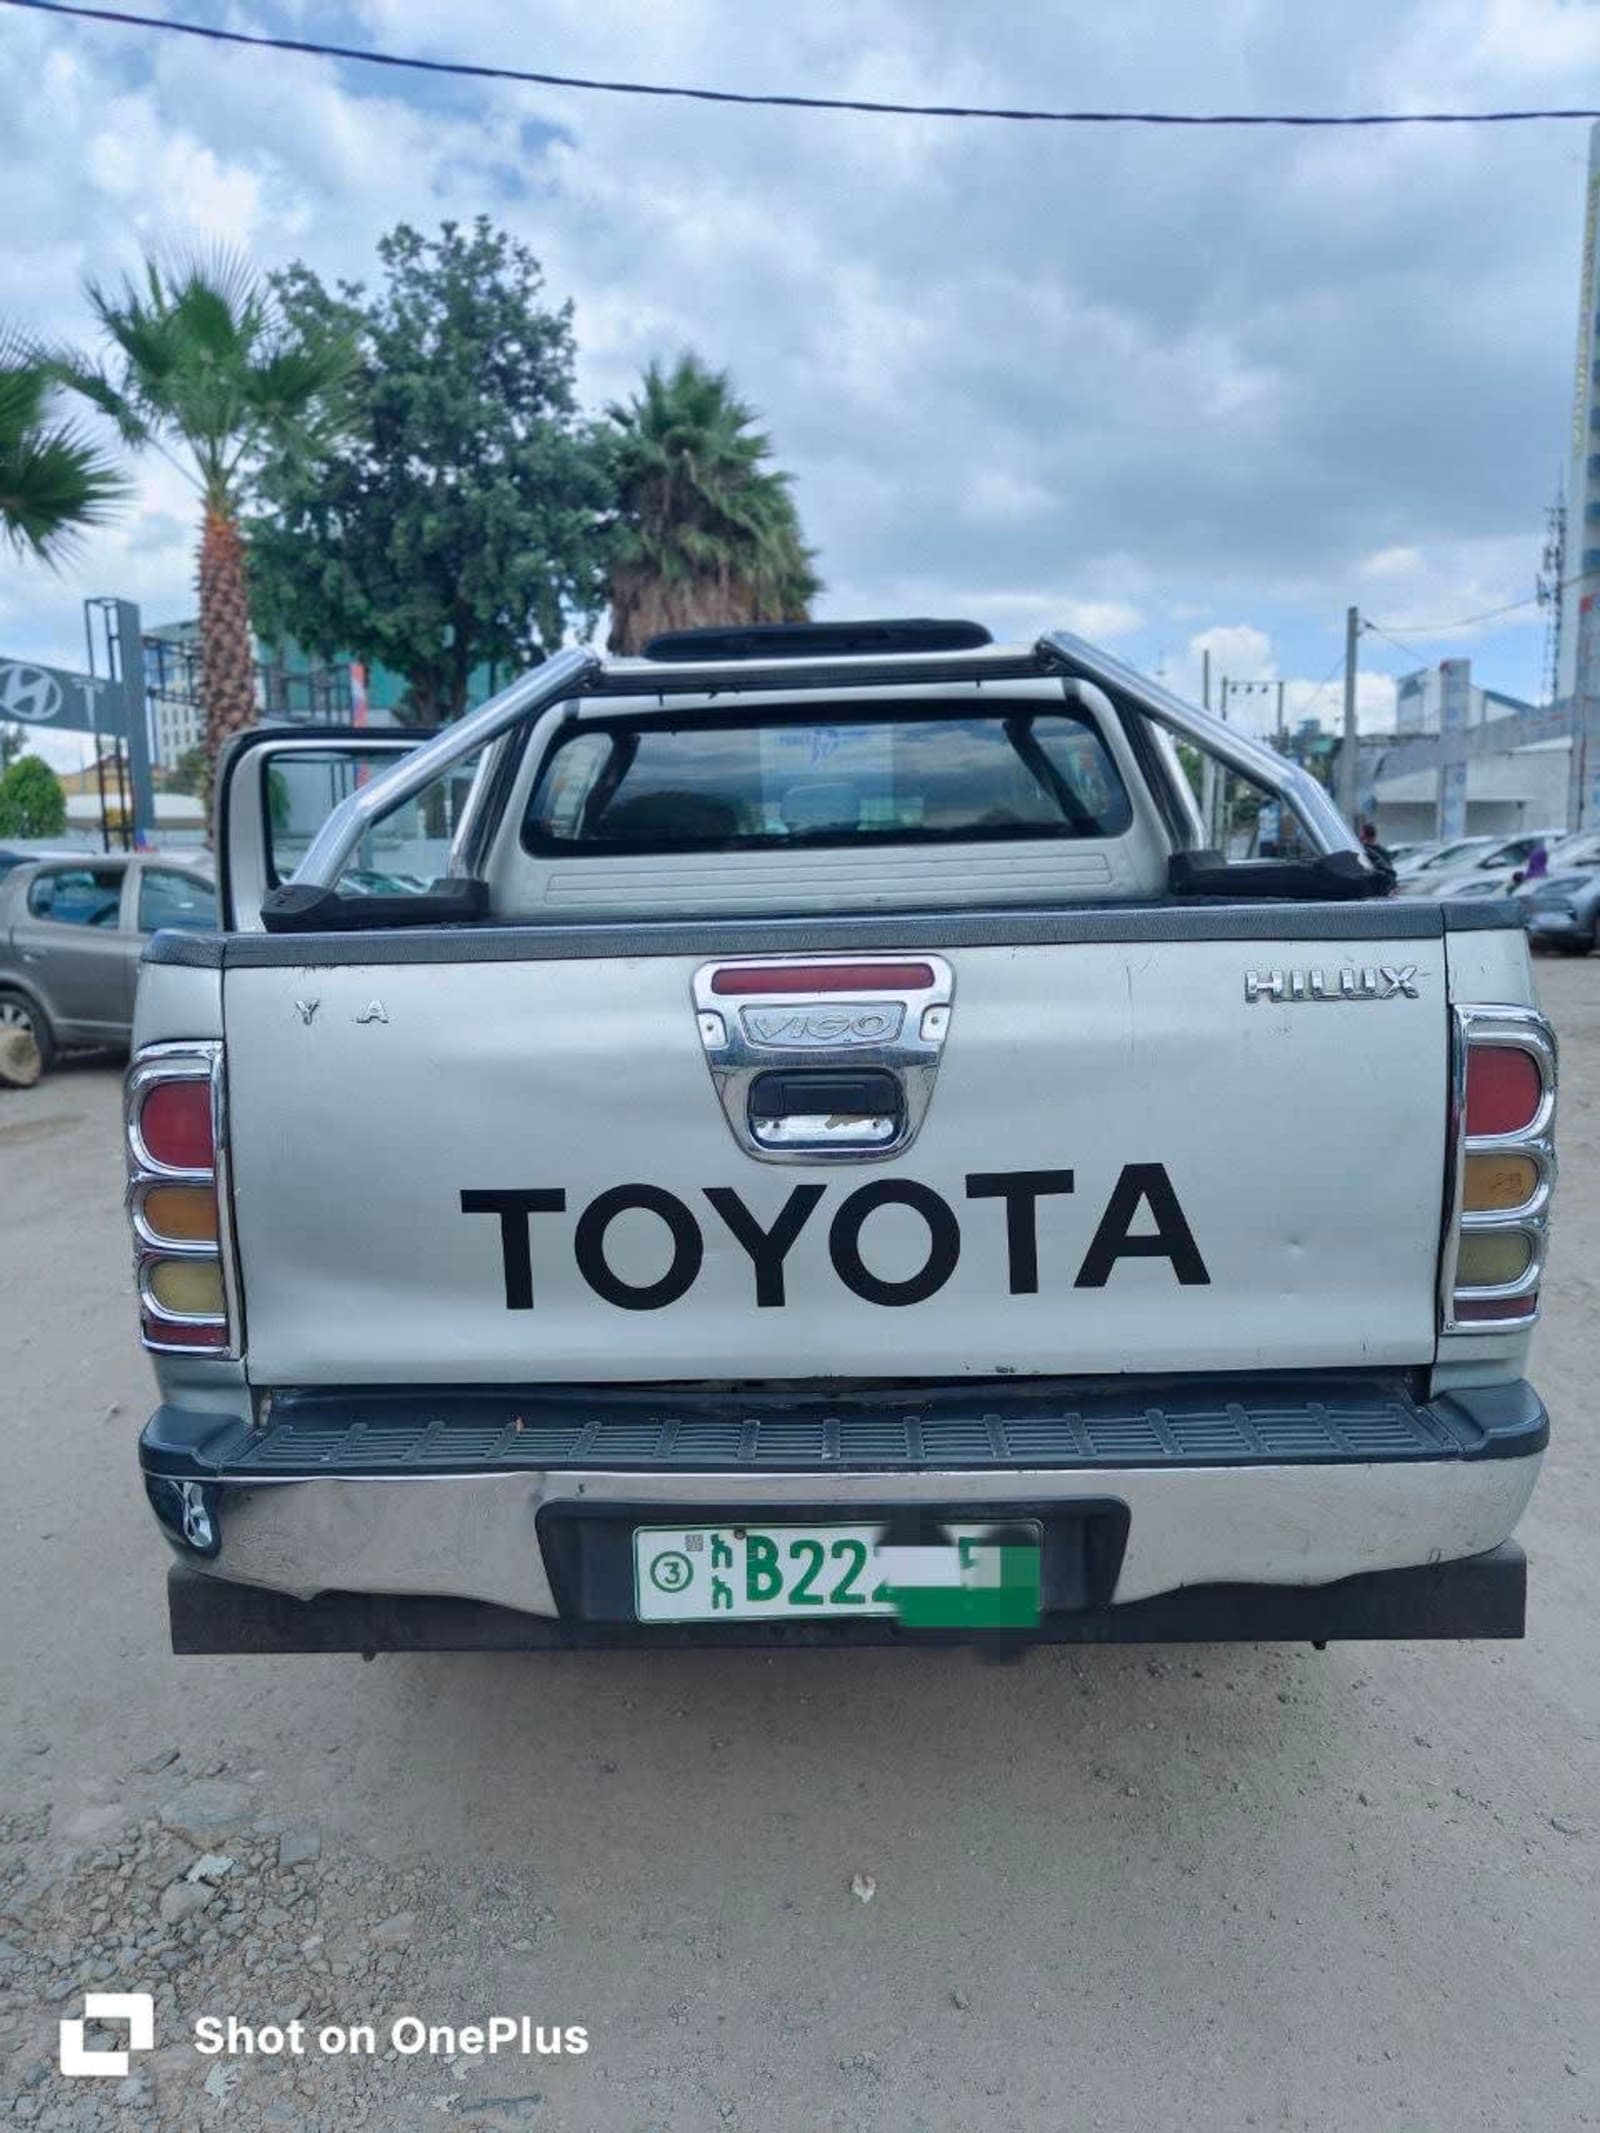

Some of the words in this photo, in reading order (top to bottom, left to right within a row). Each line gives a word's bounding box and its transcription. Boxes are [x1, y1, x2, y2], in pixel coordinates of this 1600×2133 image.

[1245, 965, 1419, 1003] HILUX
[295, 999, 320, 1025] Y
[753, 1013, 892, 1041] VIGO
[460, 1163, 1211, 1311] TOYOTA
